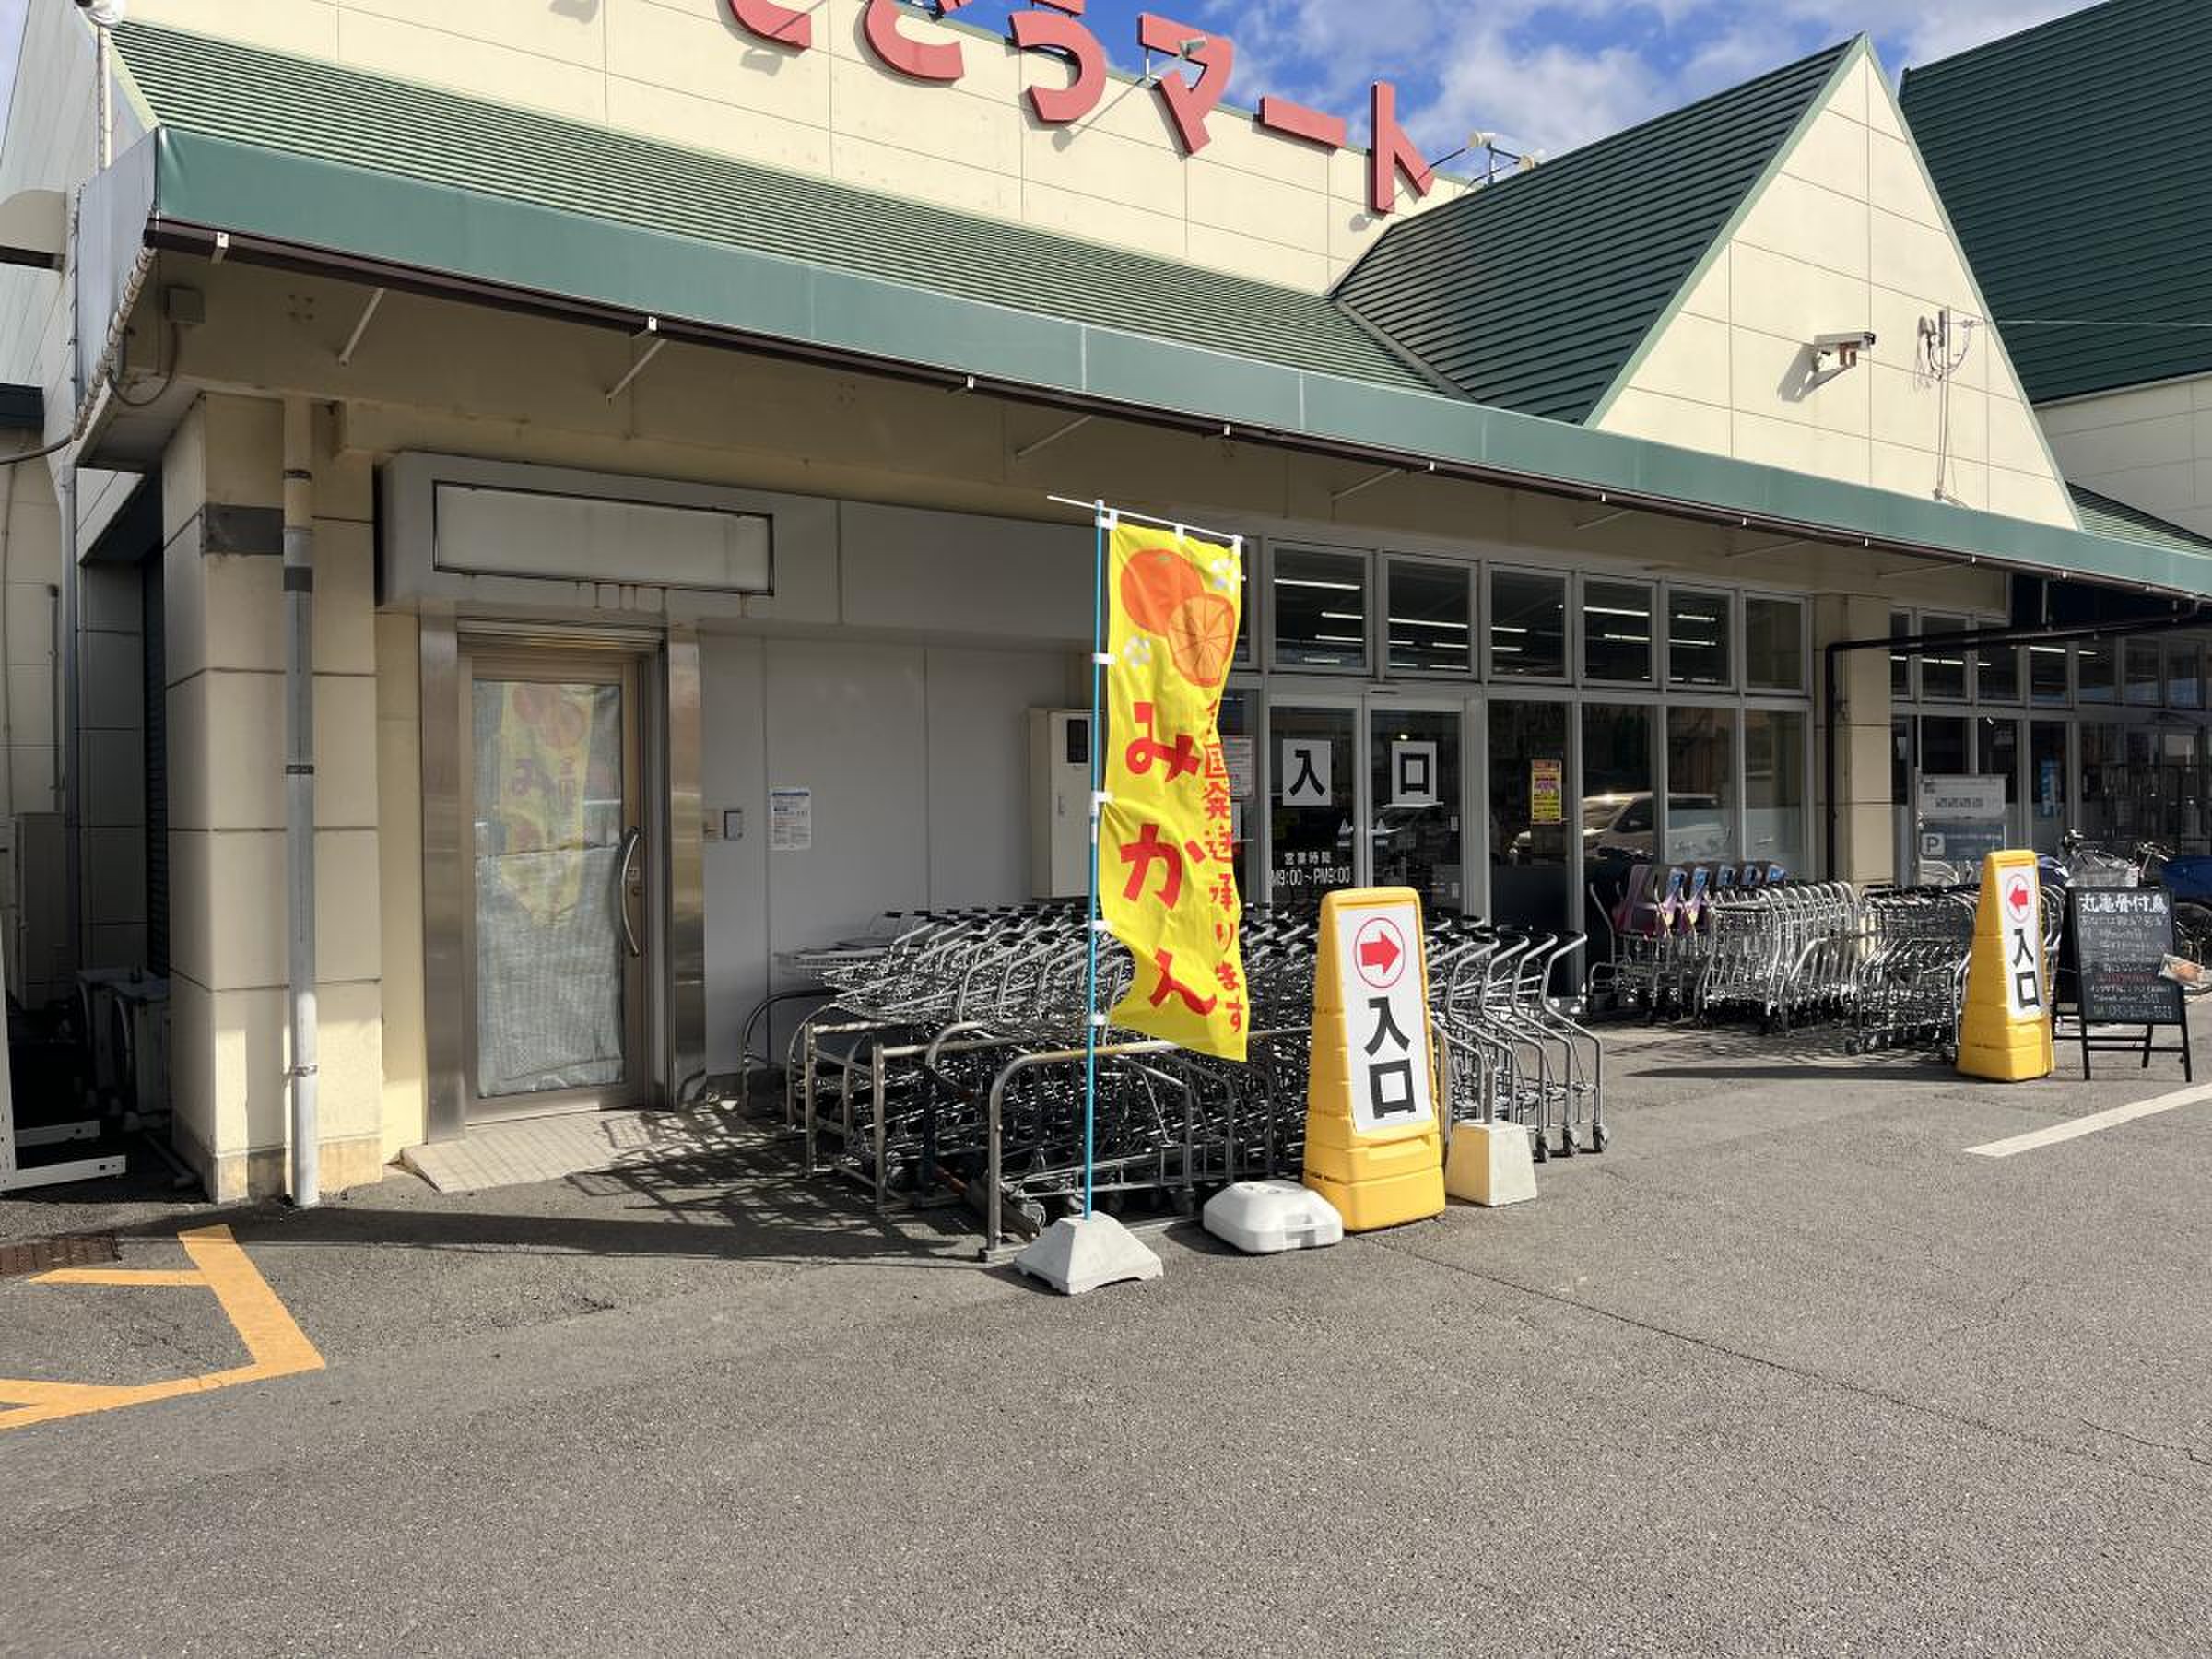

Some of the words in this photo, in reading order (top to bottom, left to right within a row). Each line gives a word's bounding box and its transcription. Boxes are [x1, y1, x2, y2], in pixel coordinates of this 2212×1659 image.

[1121, 701, 1217, 1017] みかん
[2012, 928, 2041, 1009] 入口
[1364, 996, 1417, 1120] 入口
